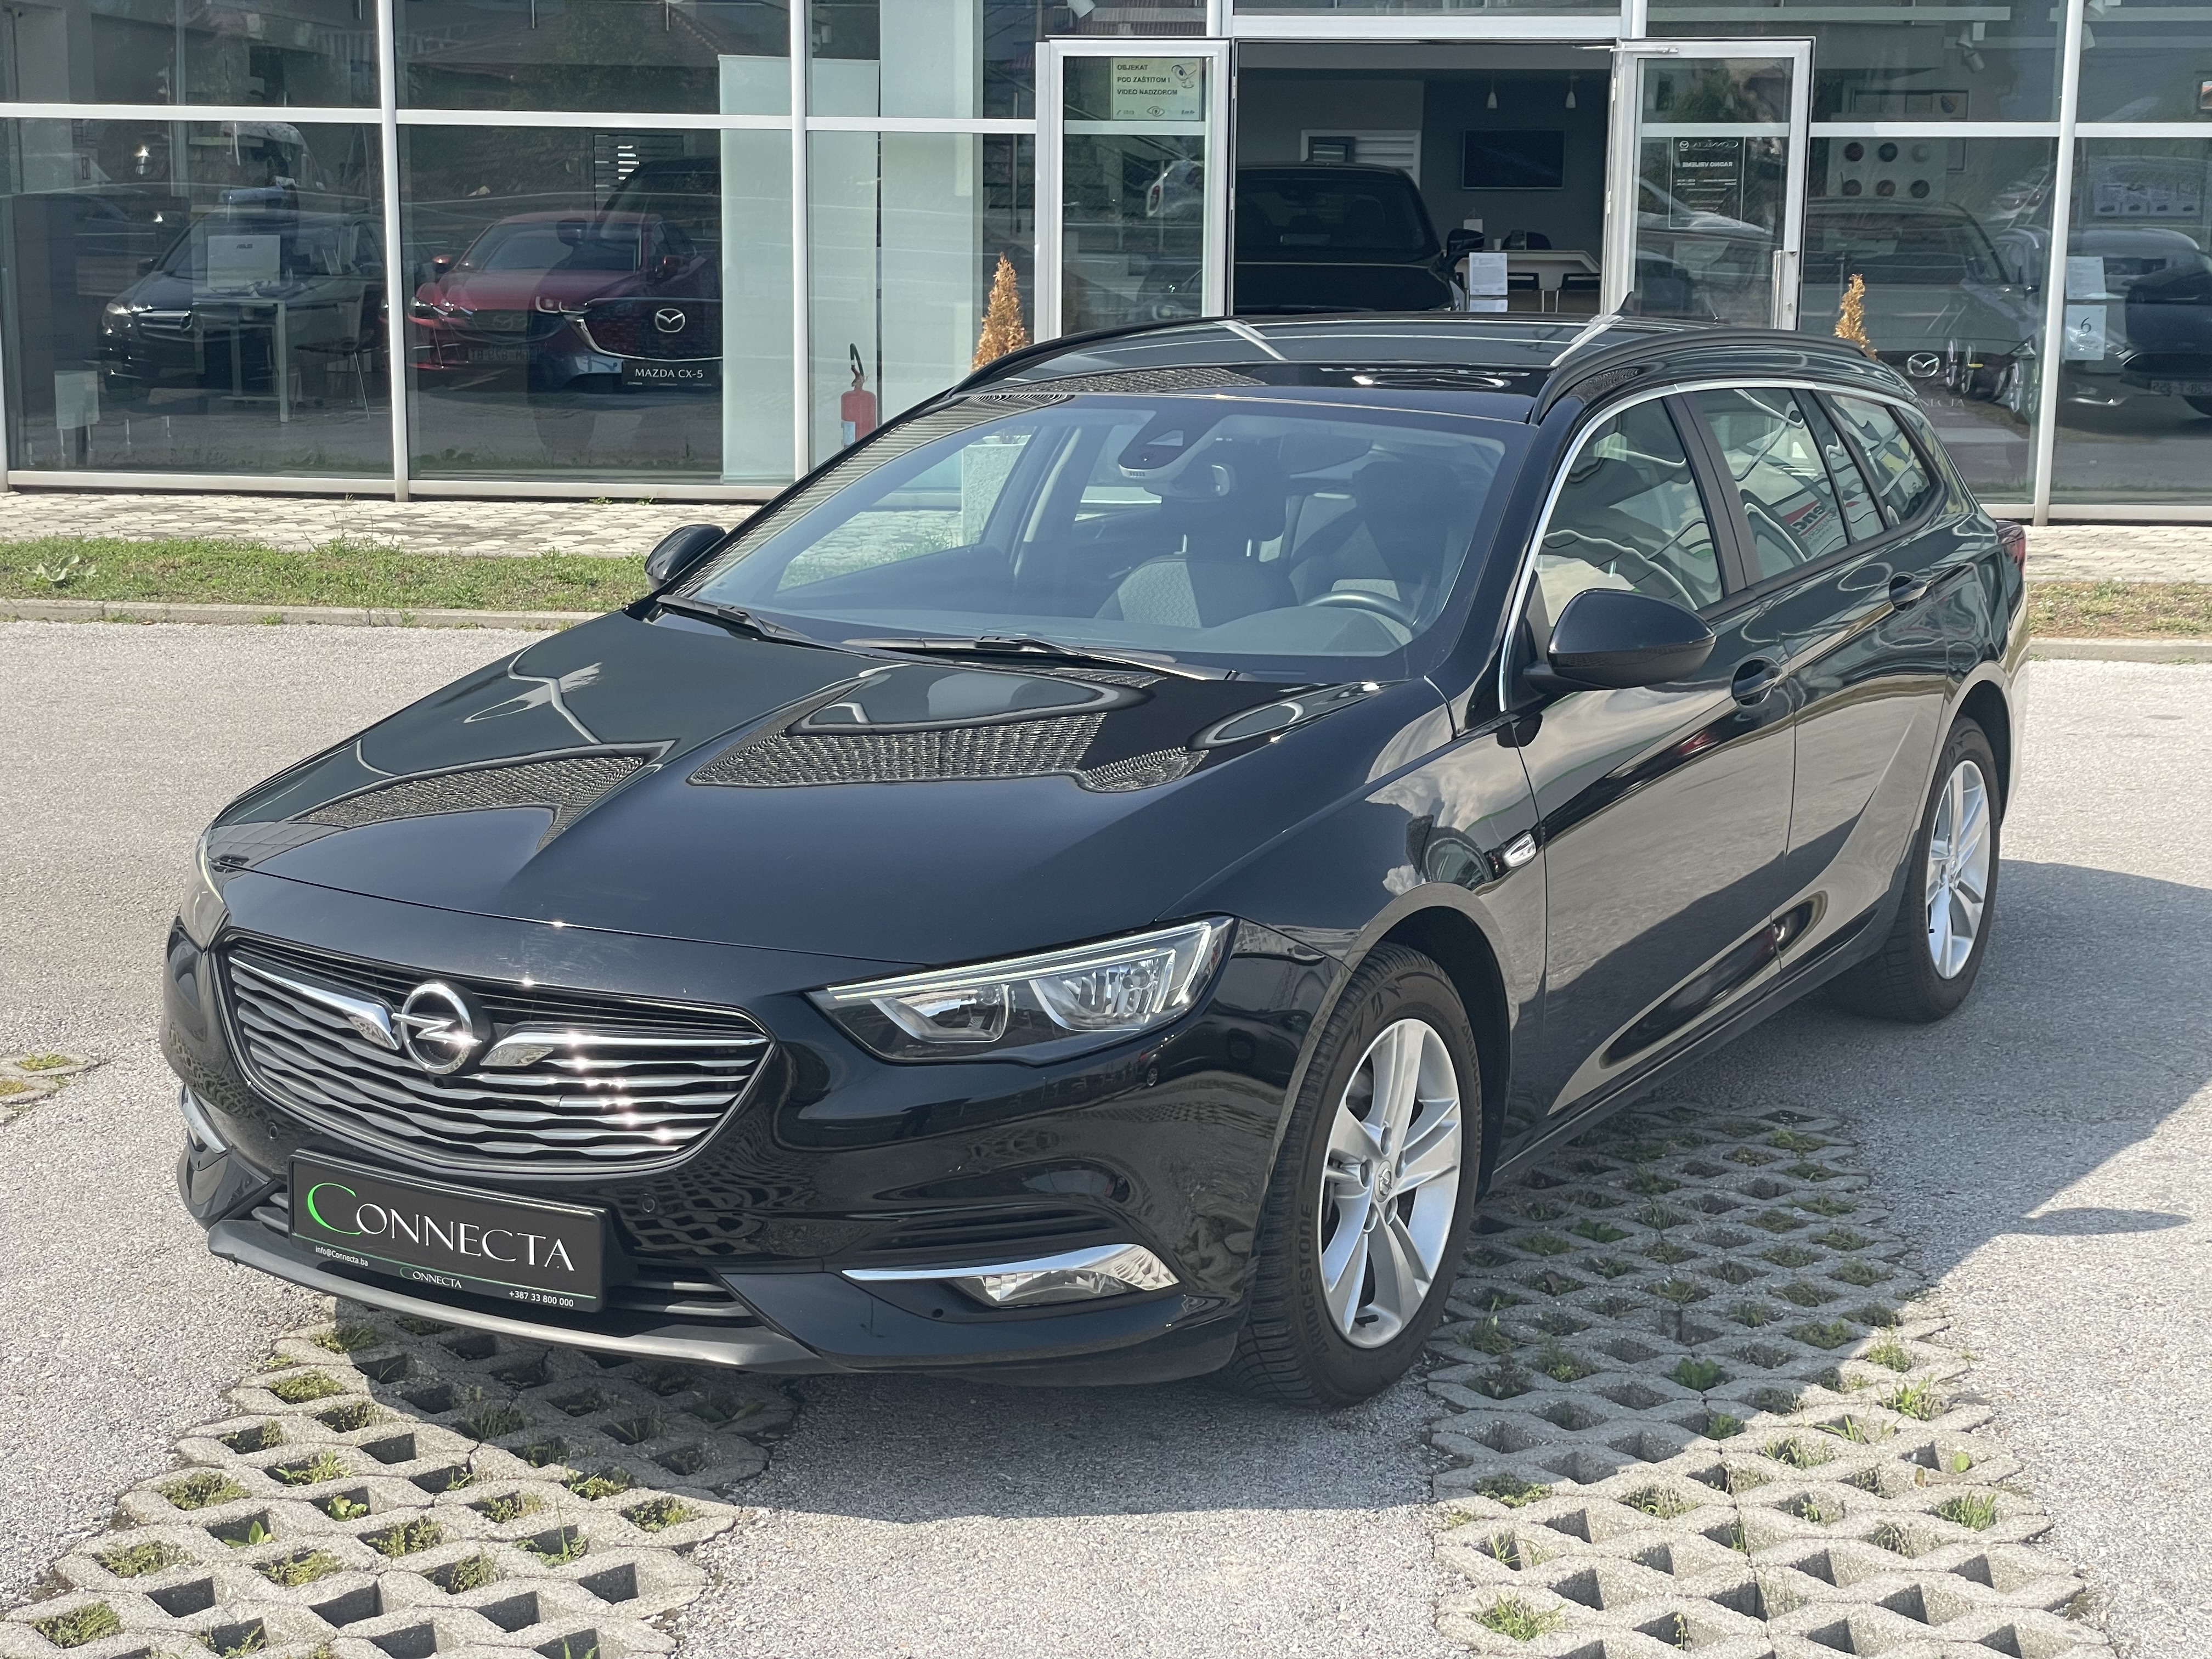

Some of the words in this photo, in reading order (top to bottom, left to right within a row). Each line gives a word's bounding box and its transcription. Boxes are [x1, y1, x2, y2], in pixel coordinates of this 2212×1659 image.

[2080, 317, 2091, 334] 6
[635, 368, 675, 377] MAZDA
[678, 369, 703, 379] CX-5
[307, 1182, 575, 1271] CONNECTA
[315, 1245, 369, 1267] info@Connecta.ba
[399, 1267, 462, 1289] CONNECTA
[509, 1290, 529, 1299] +387
[531, 1293, 541, 1302] 33
[543, 1295, 557, 1305] 800
[559, 1297, 574, 1307] 000
